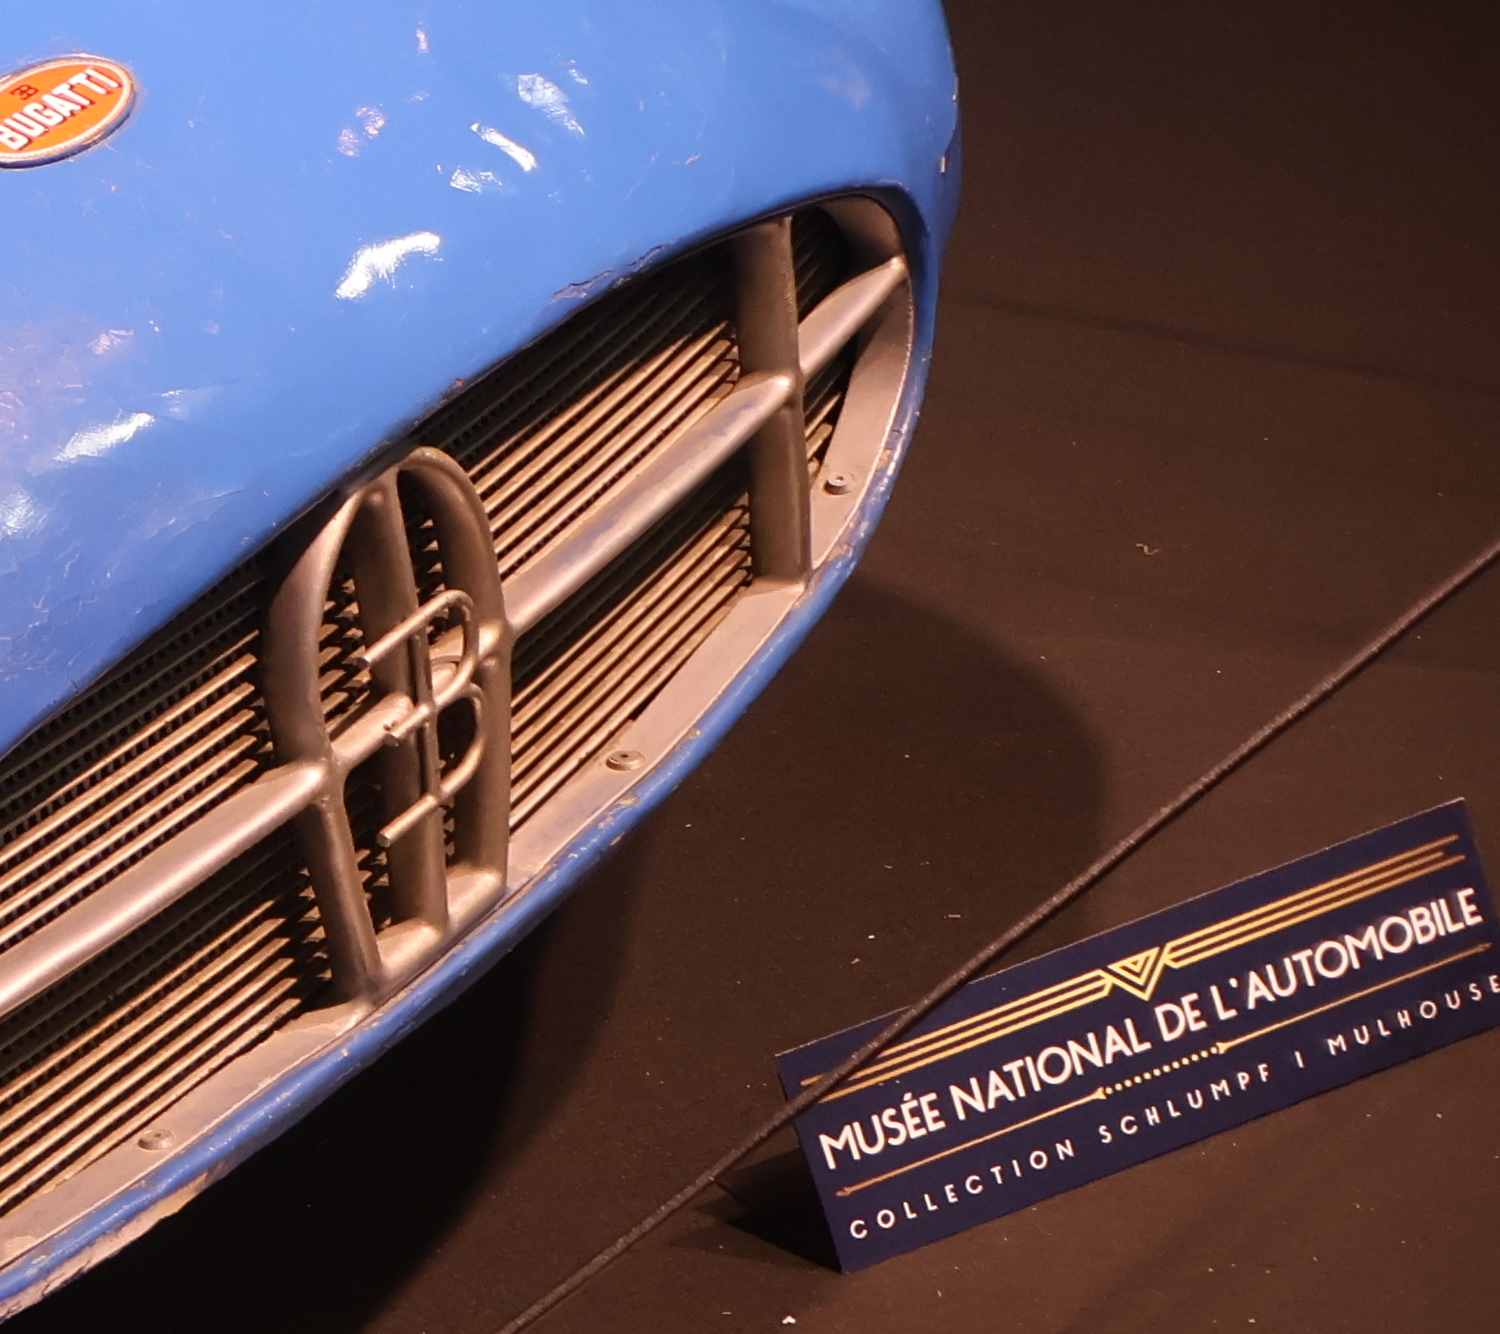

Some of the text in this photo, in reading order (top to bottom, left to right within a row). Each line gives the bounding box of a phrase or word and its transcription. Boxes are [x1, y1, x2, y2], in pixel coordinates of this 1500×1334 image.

[818, 887, 1483, 1170] MUSÉE NATIONAL DE L'AUTOMOBILE
[849, 1139, 1075, 1239] COLLECTION
[1098, 1063, 1269, 1144] SCHLUMPF
[1326, 974, 1500, 1056] MULHOUSE
